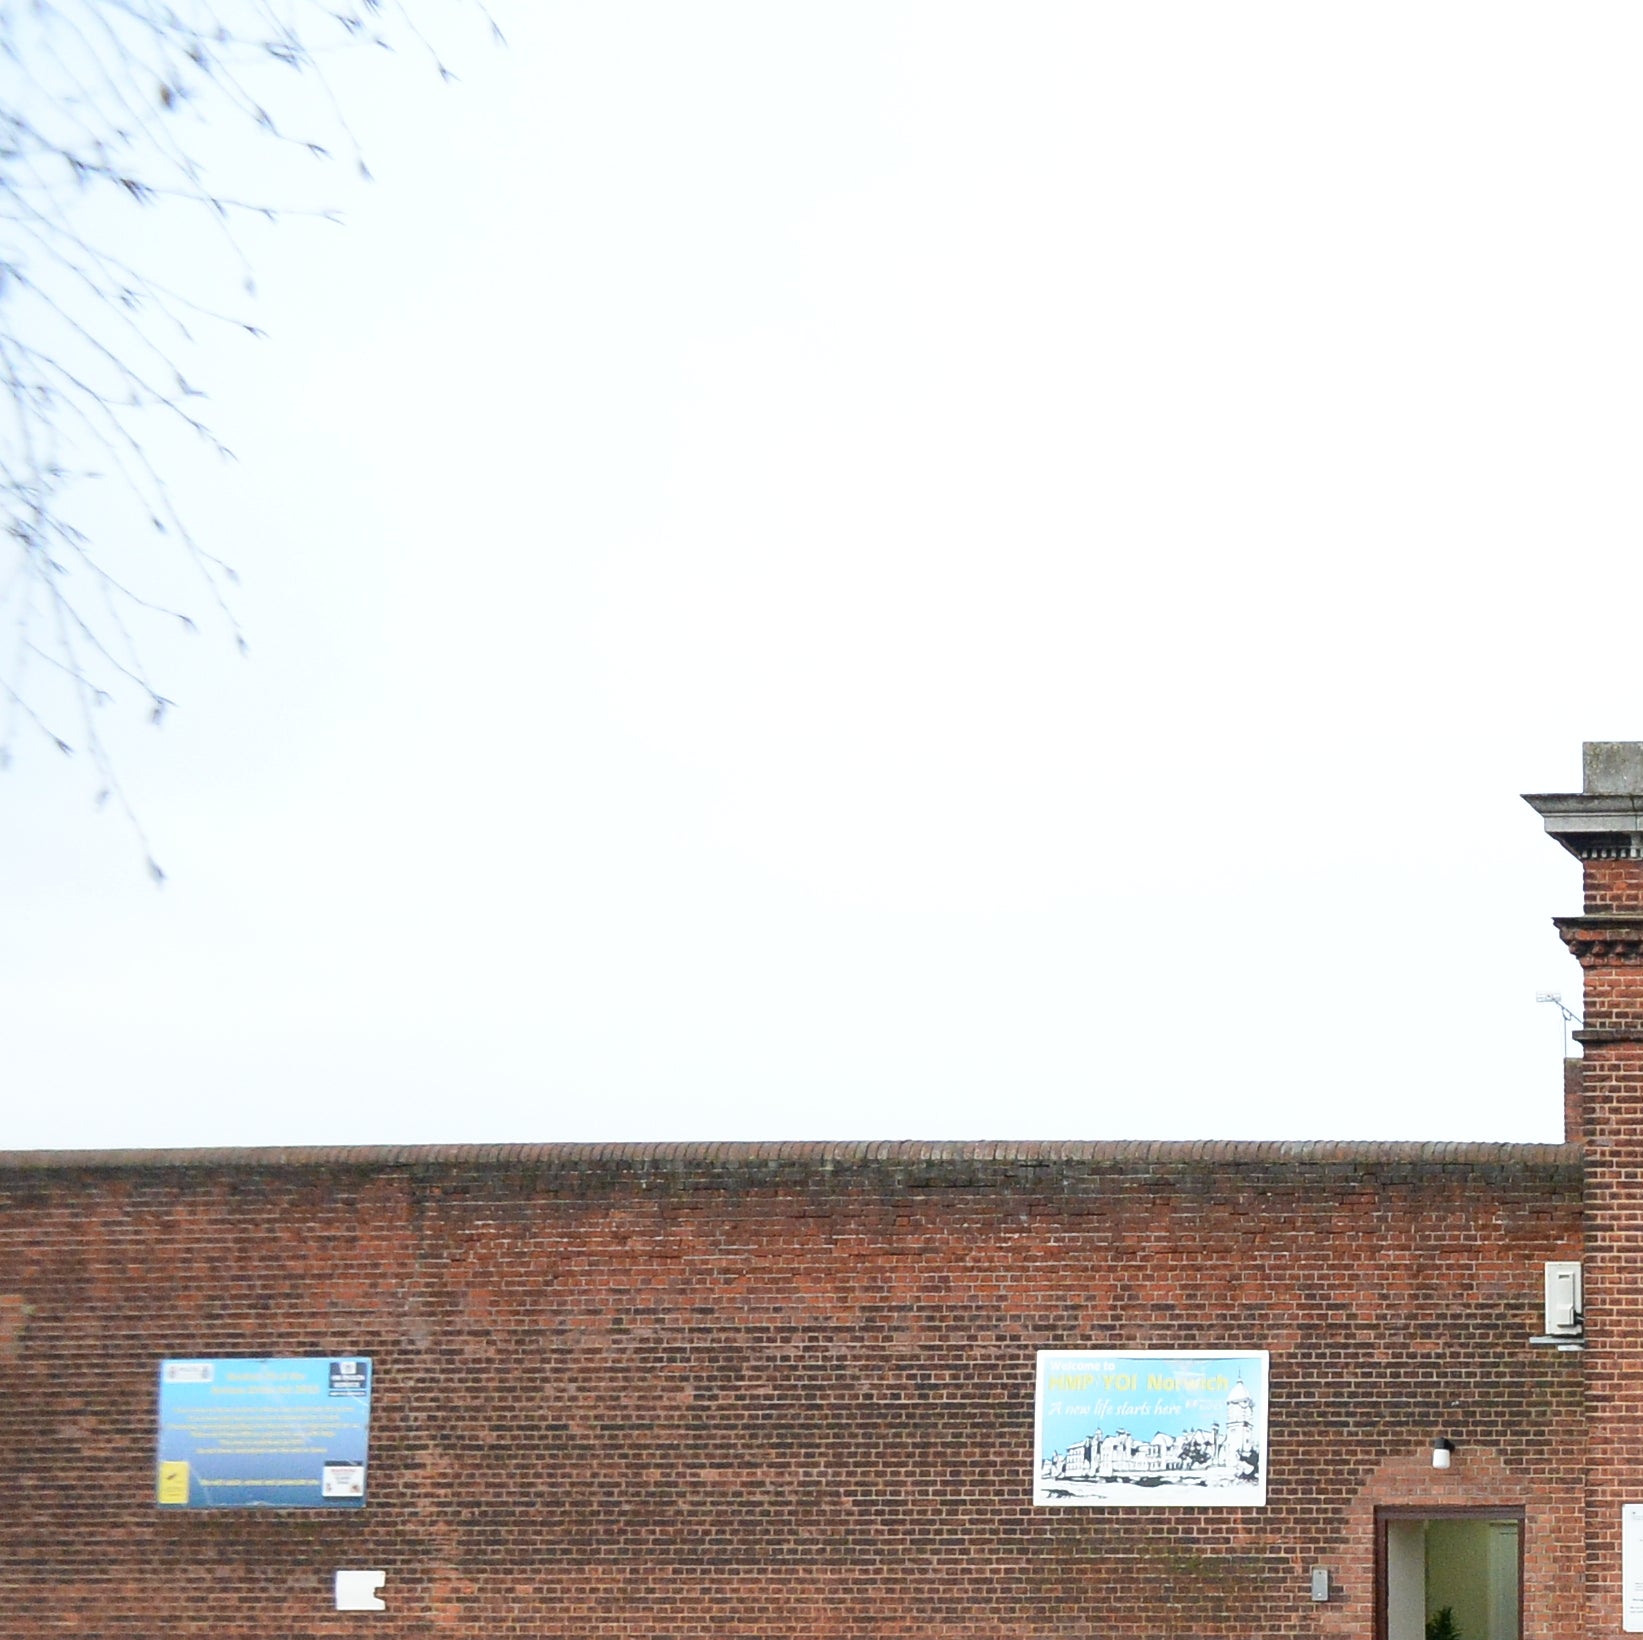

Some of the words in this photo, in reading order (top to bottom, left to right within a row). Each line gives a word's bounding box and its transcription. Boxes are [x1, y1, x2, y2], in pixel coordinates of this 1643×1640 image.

[1049, 1361, 1101, 1370] Welcome
[1103, 1361, 1116, 1370] to
[1048, 1373, 1093, 1391] HMP
[1102, 1373, 1137, 1391] YOI
[1147, 1373, 1229, 1391] Norwich
[1048, 1401, 1062, 1416] A
[1065, 1404, 1090, 1415] new
[1094, 1398, 1113, 1419] life
[1115, 1398, 1150, 1416] starts
[1154, 1398, 1182, 1416] here
